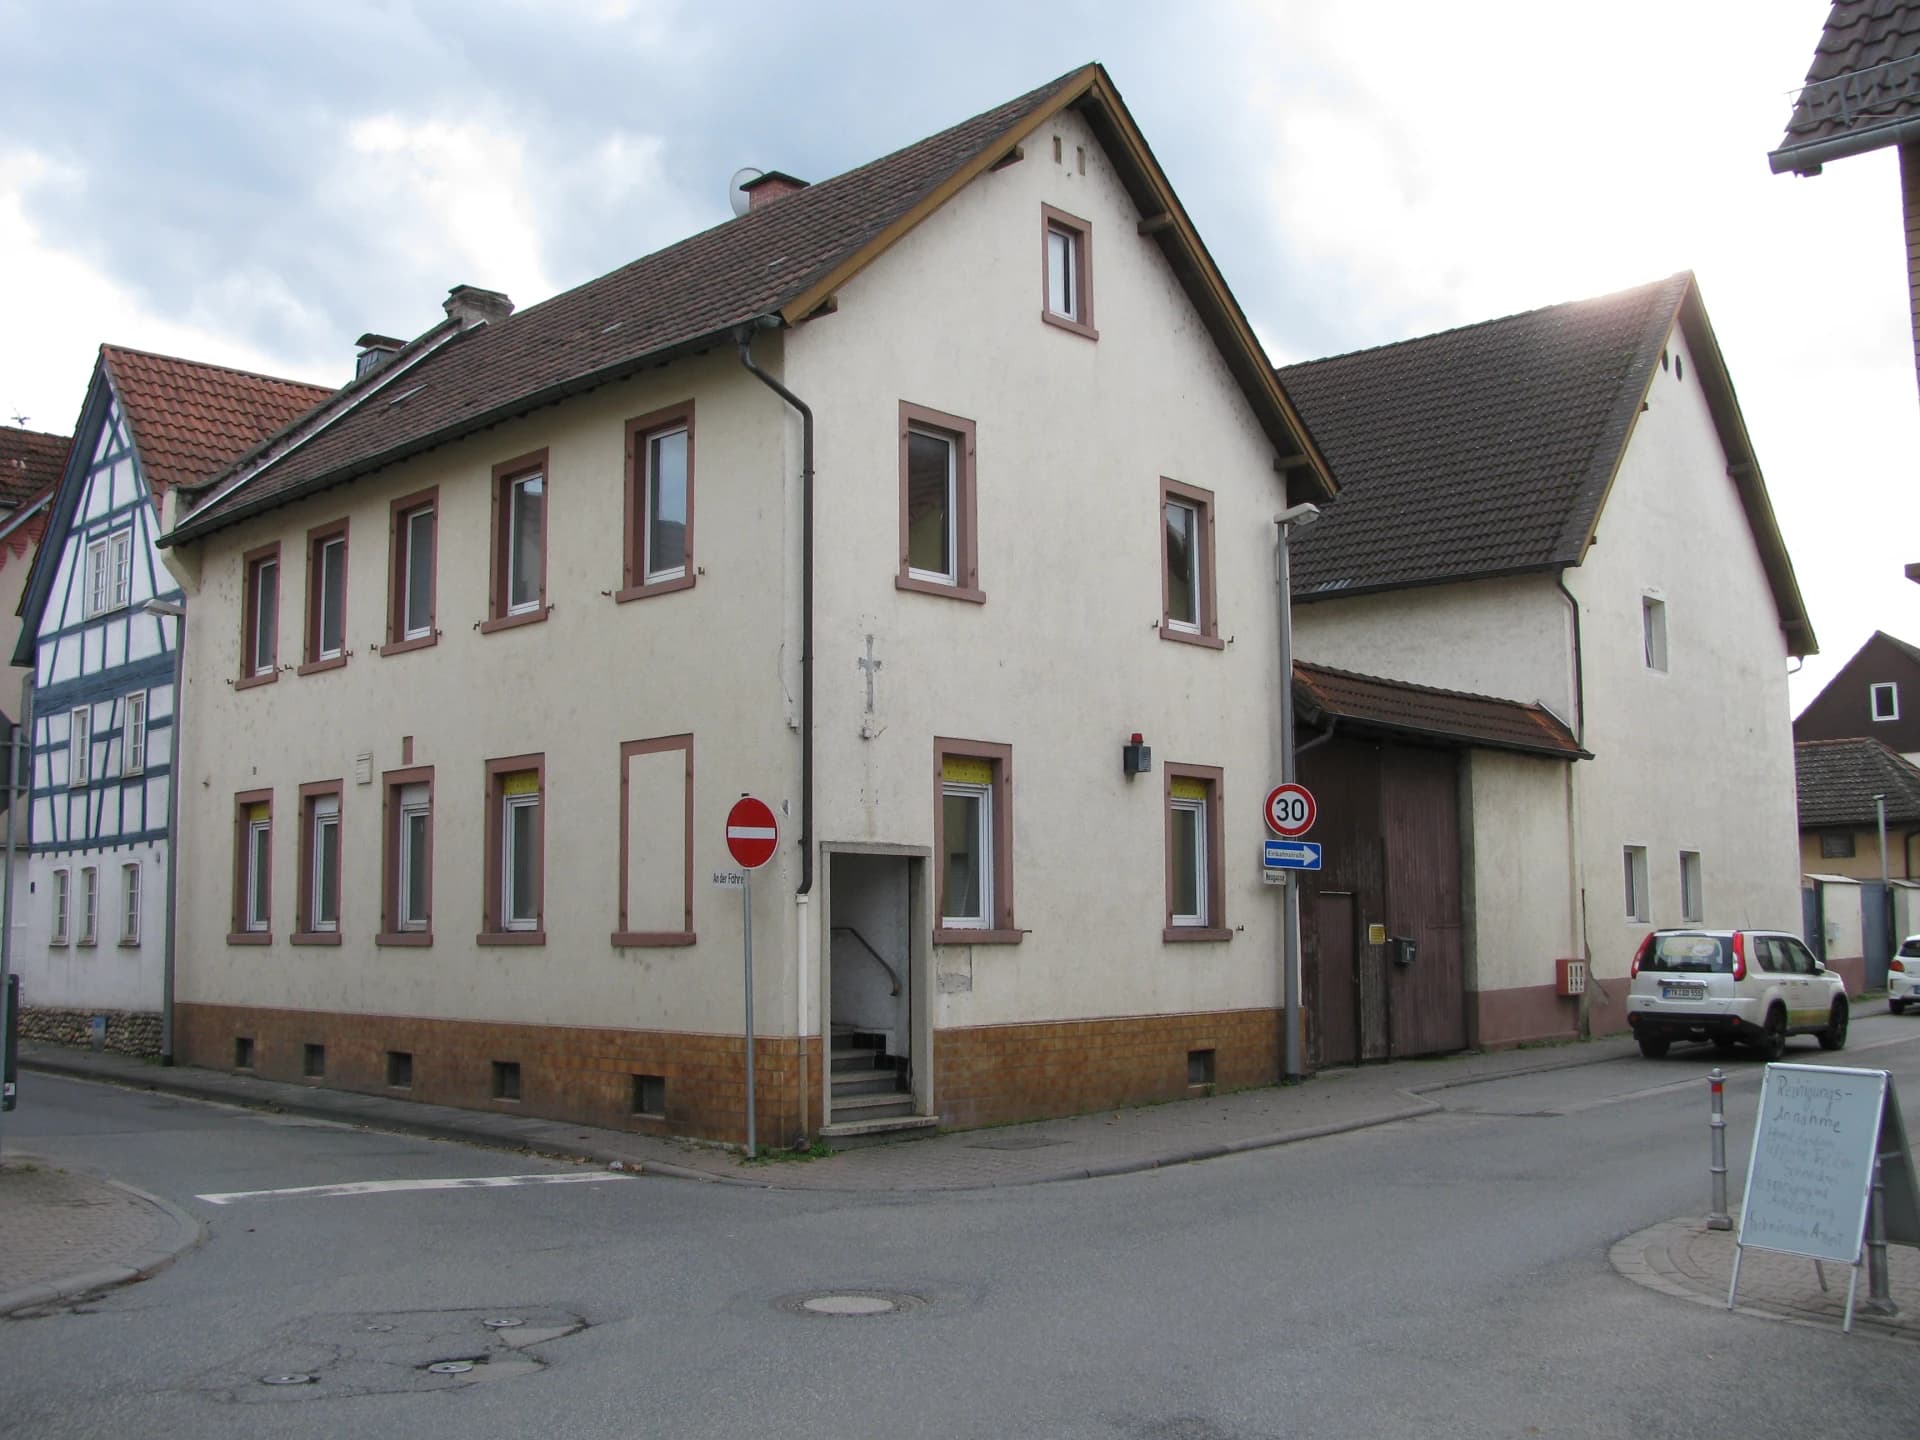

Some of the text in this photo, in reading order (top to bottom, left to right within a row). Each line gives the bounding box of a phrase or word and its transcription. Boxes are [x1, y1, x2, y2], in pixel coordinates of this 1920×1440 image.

[1276, 799, 1305, 822] 30
[1777, 1075, 1853, 1114] Reinigungs-
[1773, 1105, 1841, 1133] Annahme
